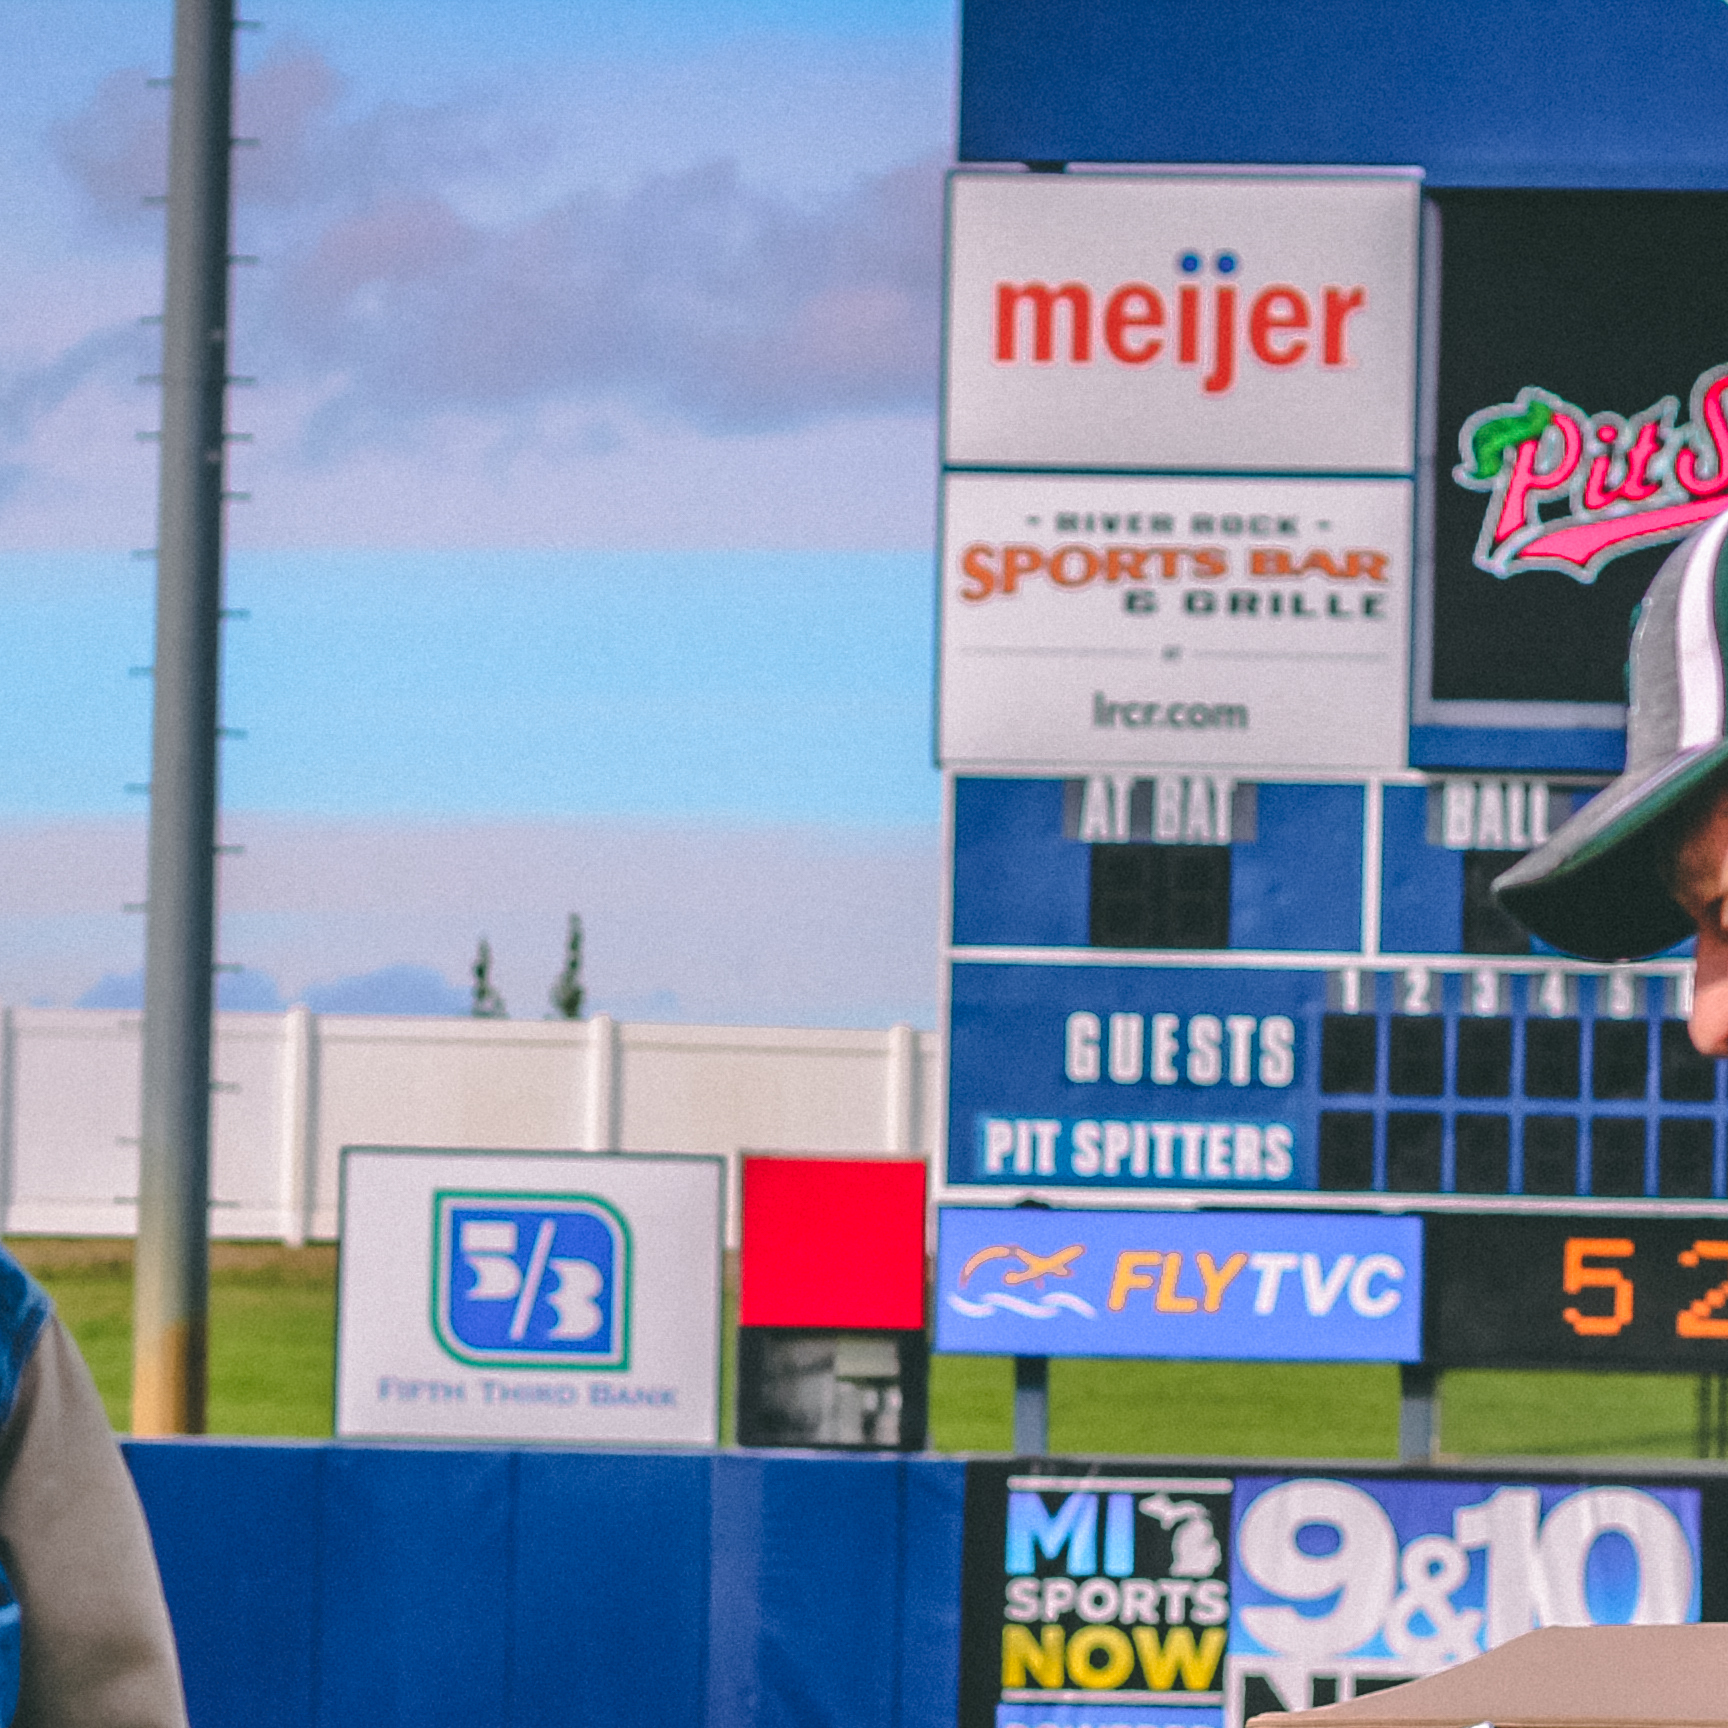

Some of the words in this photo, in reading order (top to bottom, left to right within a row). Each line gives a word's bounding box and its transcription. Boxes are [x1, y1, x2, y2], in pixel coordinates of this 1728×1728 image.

[994, 249, 1366, 393] meijer
[1494, 412, 1659, 543] Pit
[1056, 512, 1175, 534] RIVER
[1191, 514, 1300, 536] ROCK
[960, 544, 1228, 602] SPORTS
[1249, 546, 1389, 582] BAR
[1184, 590, 1388, 620] GRILLE
[1094, 693, 1250, 730] lrcr.com
[1080, 780, 1132, 844] AT
[1152, 780, 1234, 845] BAT
[1341, 966, 1360, 1015] 1
[1405, 966, 1429, 1016] 2
[1474, 967, 1498, 1017] 3
[1539, 969, 1566, 1018] 4
[1609, 970, 1633, 1020] 5
[1065, 1011, 1295, 1087] GUESTS
[984, 1118, 1060, 1175] PIT
[1071, 1119, 1293, 1181] SPITTERS
[1109, 1249, 1403, 1317] FLYTVC
[1563, 1238, 1635, 1336] 5
[380, 1376, 466, 1402] FIFTH
[482, 1379, 577, 1405] THIRD
[589, 1381, 676, 1407] BANK
[1005, 1492, 1134, 1577] MI
[1005, 1576, 1229, 1624] SPORTS
[1239, 1478, 1702, 1662] 9&10
[1002, 1623, 1228, 1690] NOW
